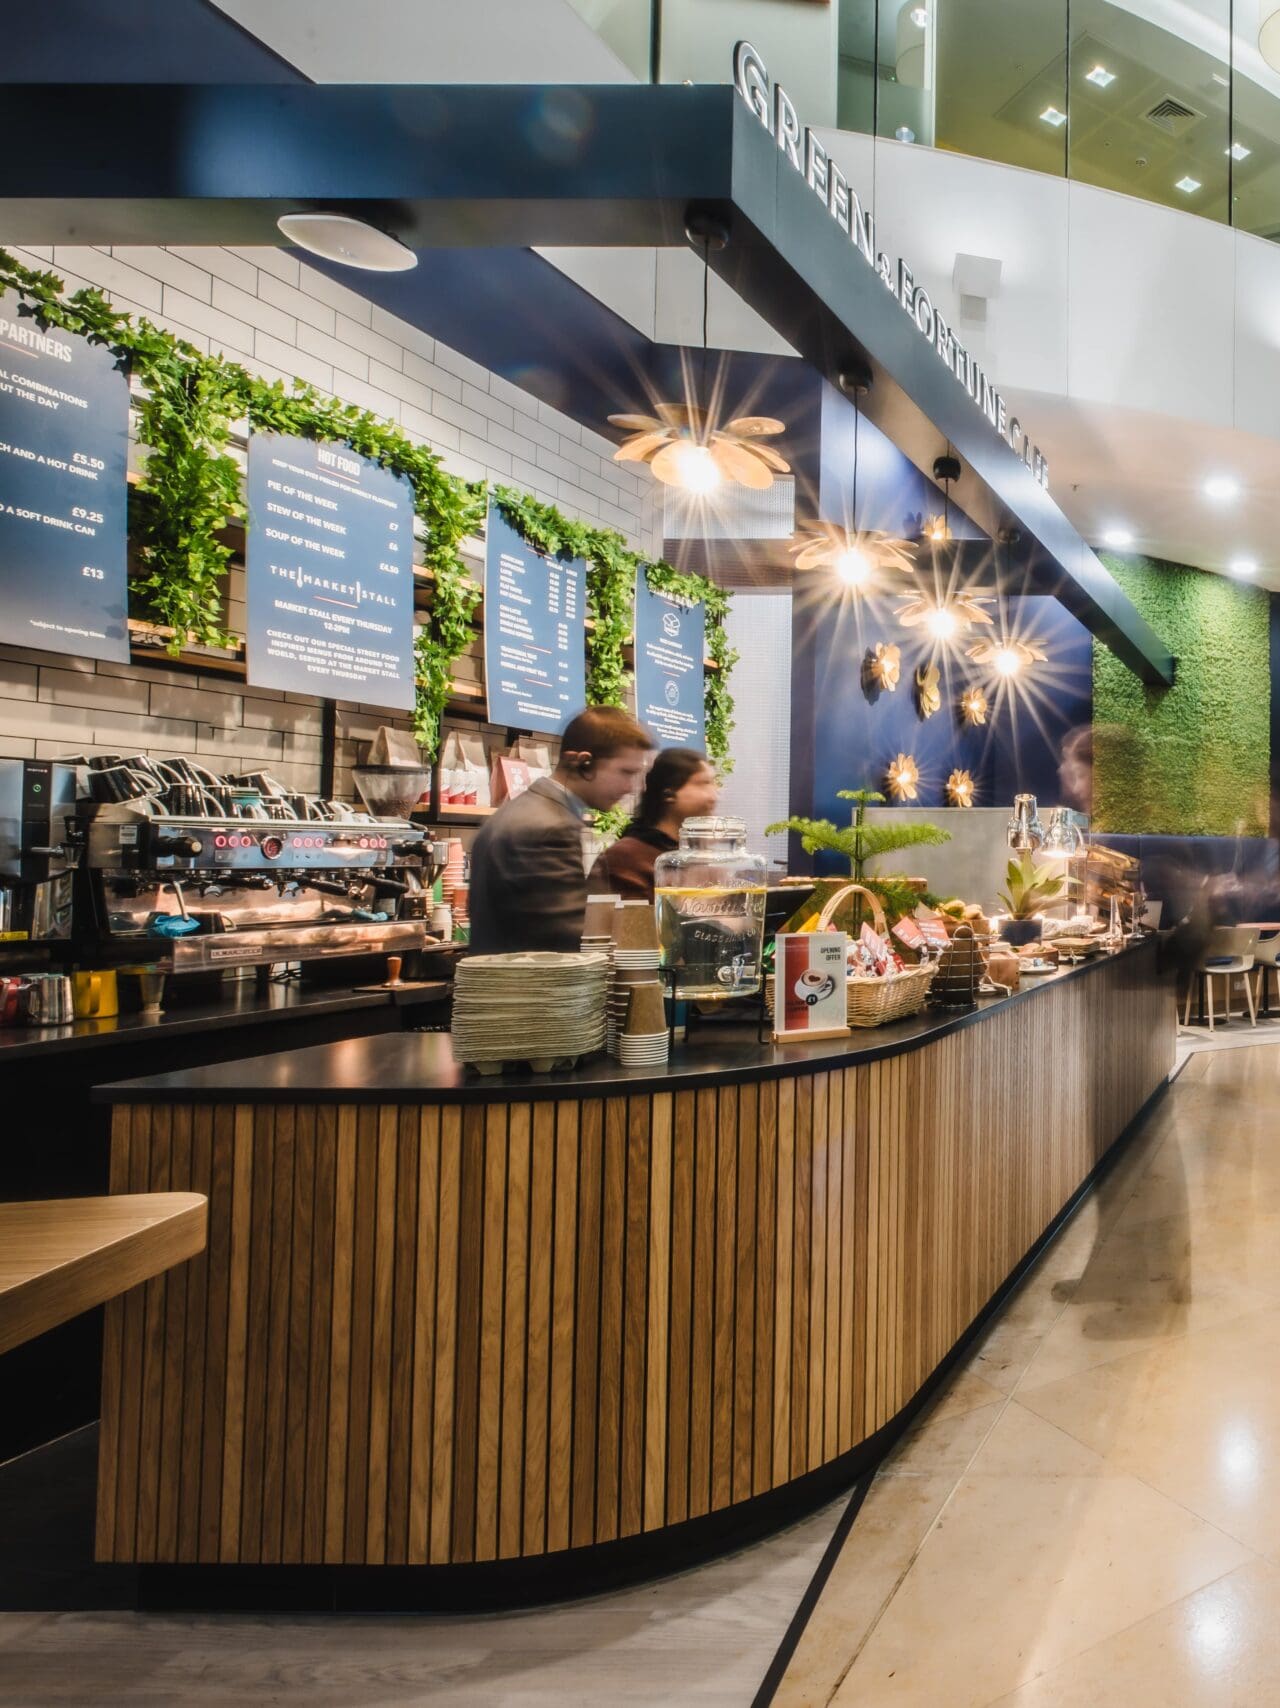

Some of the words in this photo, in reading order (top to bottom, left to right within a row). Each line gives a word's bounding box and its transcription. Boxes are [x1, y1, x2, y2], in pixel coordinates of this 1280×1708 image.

[733, 40, 875, 267] GREEN
[878, 253, 895, 293] &
[898, 258, 1006, 435] FORTUNE
[0, 318, 72, 362] PARTNERS
[11, 374, 88, 409] COMBINATIONS
[16, 387, 36, 402] THE
[38, 395, 60, 410] DAY
[13, 447, 35, 460] AND
[37, 455, 46, 464] A
[47, 458, 68, 472] HOT
[69, 465, 98, 481] DRINK
[73, 452, 104, 470] £5.50
[318, 448, 336, 467] HOT
[337, 454, 361, 477] FOOD
[267, 480, 282, 492] PIE
[283, 485, 297, 496] OF
[297, 489, 313, 502] THE
[314, 495, 338, 511] WEEK
[6, 506, 15, 515] A
[16, 508, 42, 523] SOFT
[43, 515, 73, 531] DRINK
[74, 523, 96, 537] CAN
[72, 507, 104, 525] £9.25
[267, 502, 291, 517] STEW
[292, 510, 305, 520] OF
[305, 514, 322, 527] THE
[322, 520, 347, 535] WEEK
[265, 527, 290, 542] SOUP
[290, 535, 304, 546] OF
[304, 539, 321, 552] THE
[321, 545, 345, 559] WEEK
[82, 566, 104, 580] £13
[270, 565, 296, 580] THE
[303, 575, 355, 595] MARKET
[362, 590, 397, 607] STALL
[275, 599, 308, 614] MARKET
[309, 608, 331, 621] STALL
[331, 613, 356, 625] EVERY
[356, 618, 393, 634] THURSDAY
[266, 629, 292, 641] CHECK
[293, 635, 309, 644] OUT
[310, 638, 327, 648] OUR
[327, 641, 357, 654] SPECIAL
[356, 648, 380, 659] STREET
[381, 653, 400, 663] FOOD
[267, 647, 297, 660] WORLD,
[299, 654, 327, 665] SERVED
[327, 659, 338, 667] AT
[338, 661, 352, 670] THE
[271, 639, 306, 652] INSPIRED
[333, 651, 354, 662] FROM
[383, 661, 397, 671] THE
[306, 664, 331, 676] EVERY
[331, 668, 367, 681] THURSDAY
[820, 946, 841, 954] OPENING
